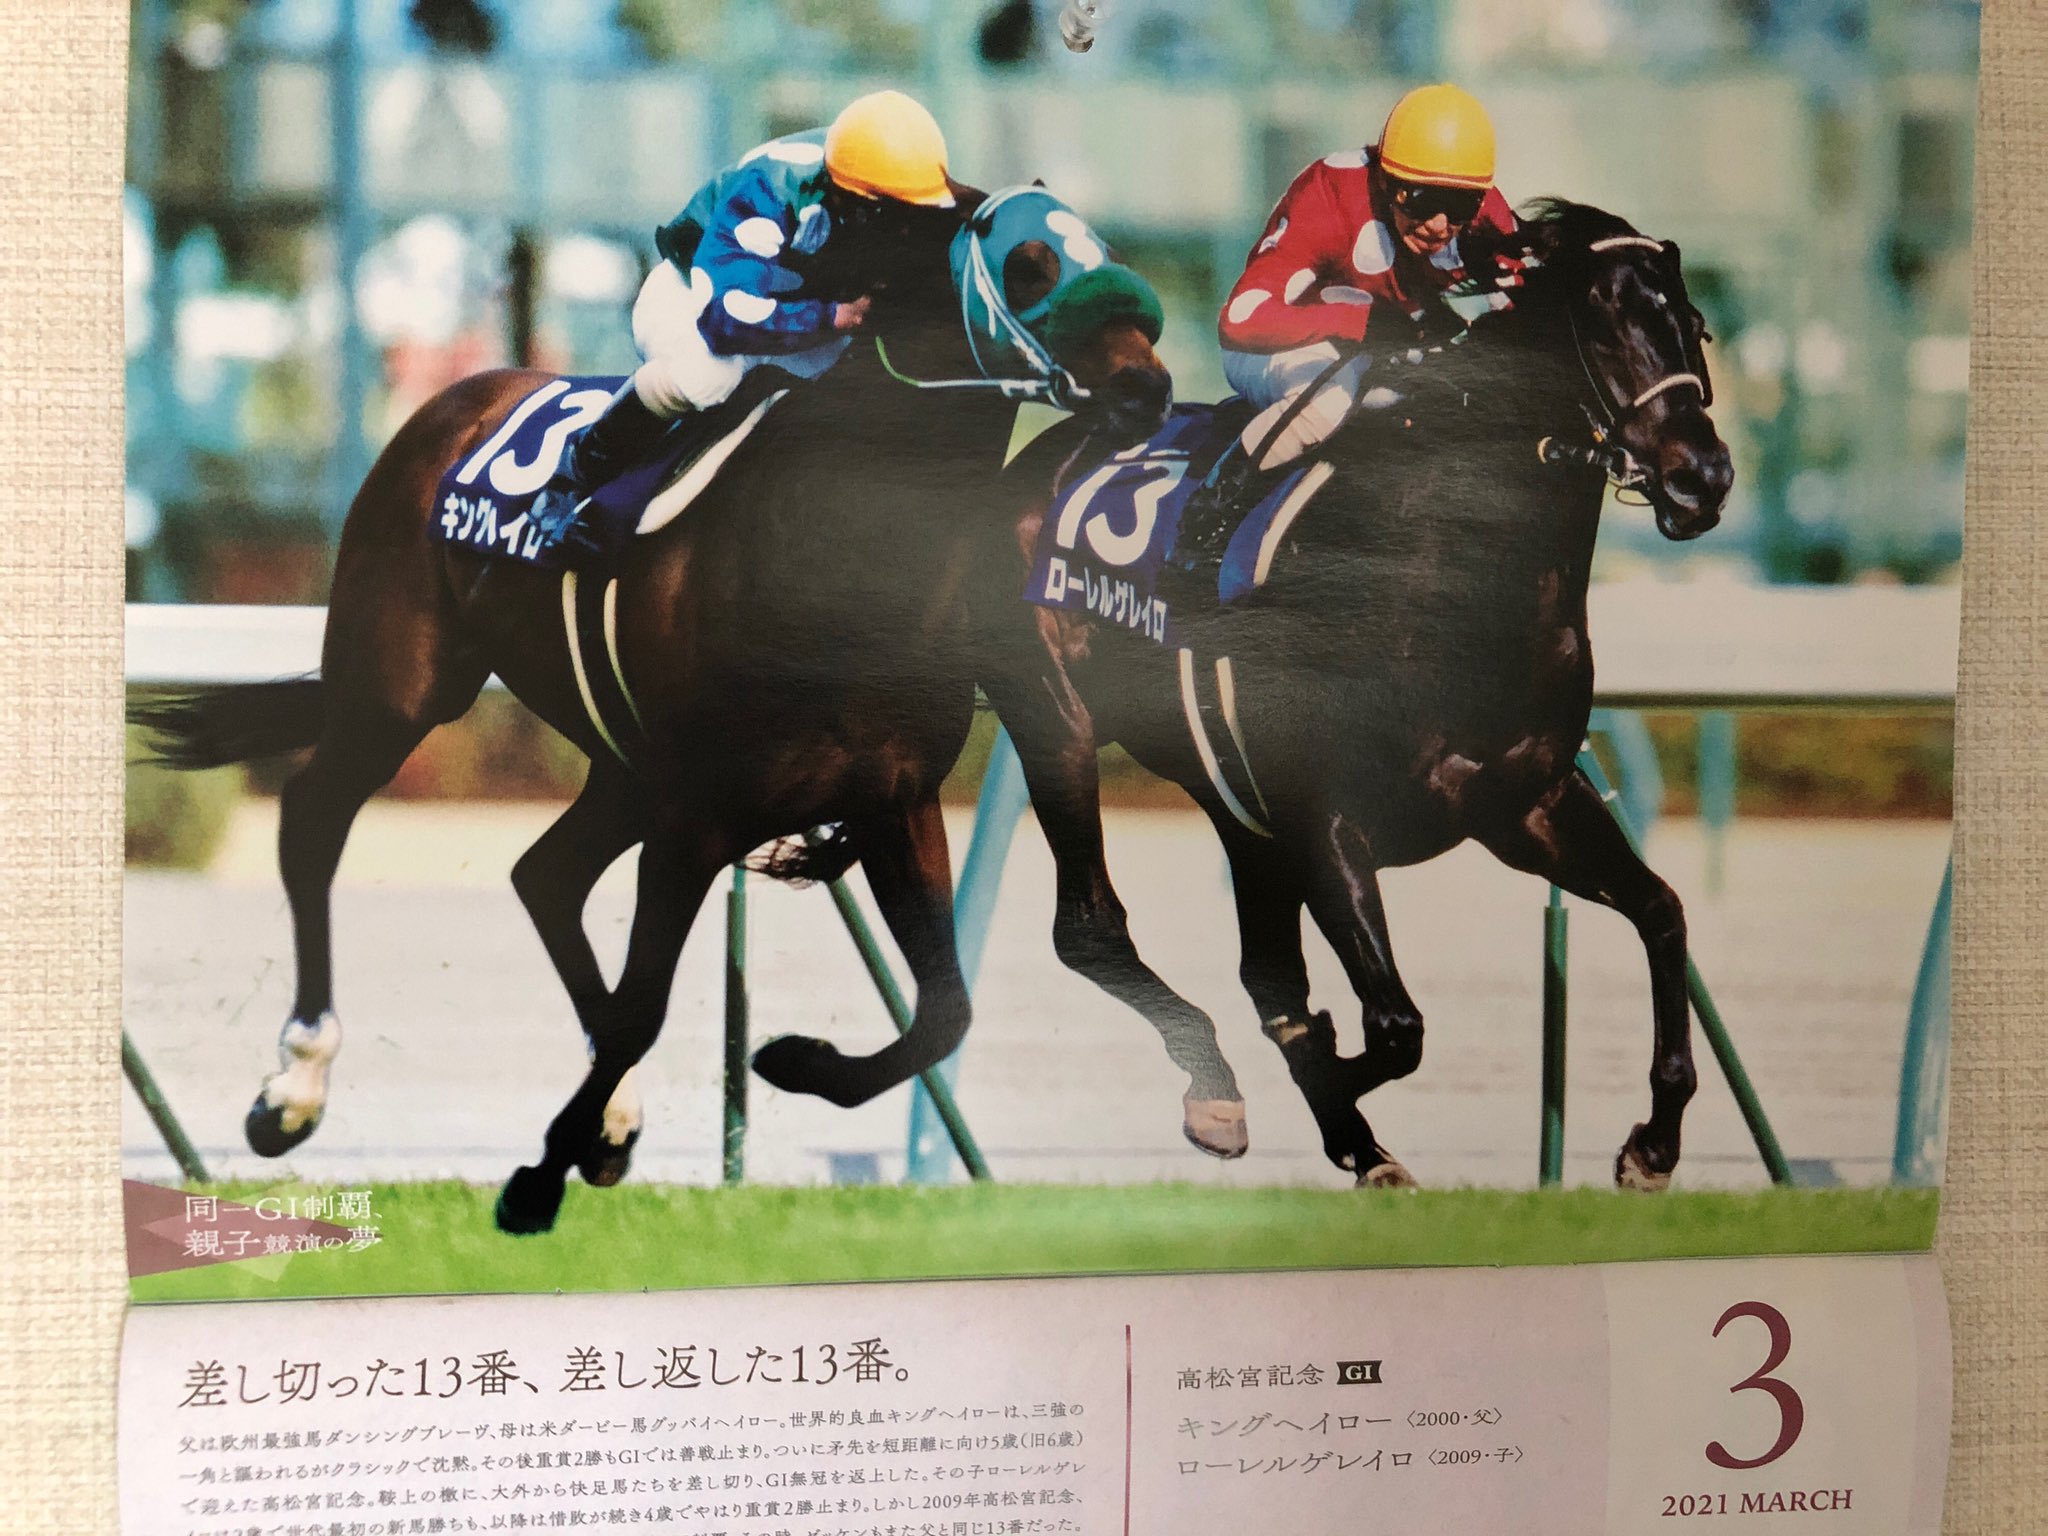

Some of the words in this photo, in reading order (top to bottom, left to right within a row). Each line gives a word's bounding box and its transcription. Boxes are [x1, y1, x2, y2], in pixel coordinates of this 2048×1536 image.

[456, 380, 613, 496] 13
[1057, 443, 1190, 566] 13
[1044, 556, 1168, 643] ローレルゲレイロ
[184, 1190, 383, 1223] 同一GI制覇、
[182, 1225, 383, 1257] 親子競演の夢
[1176, 1363, 1326, 1391] 高松宮記念
[1705, 1301, 1804, 1470] 3
[1177, 1411, 1392, 1440] キングヘイロー
[1178, 1449, 1413, 1475] ローレルゲレイロ
[1661, 1494, 1729, 1518] 2021
[1739, 1489, 1854, 1513] MARCH
